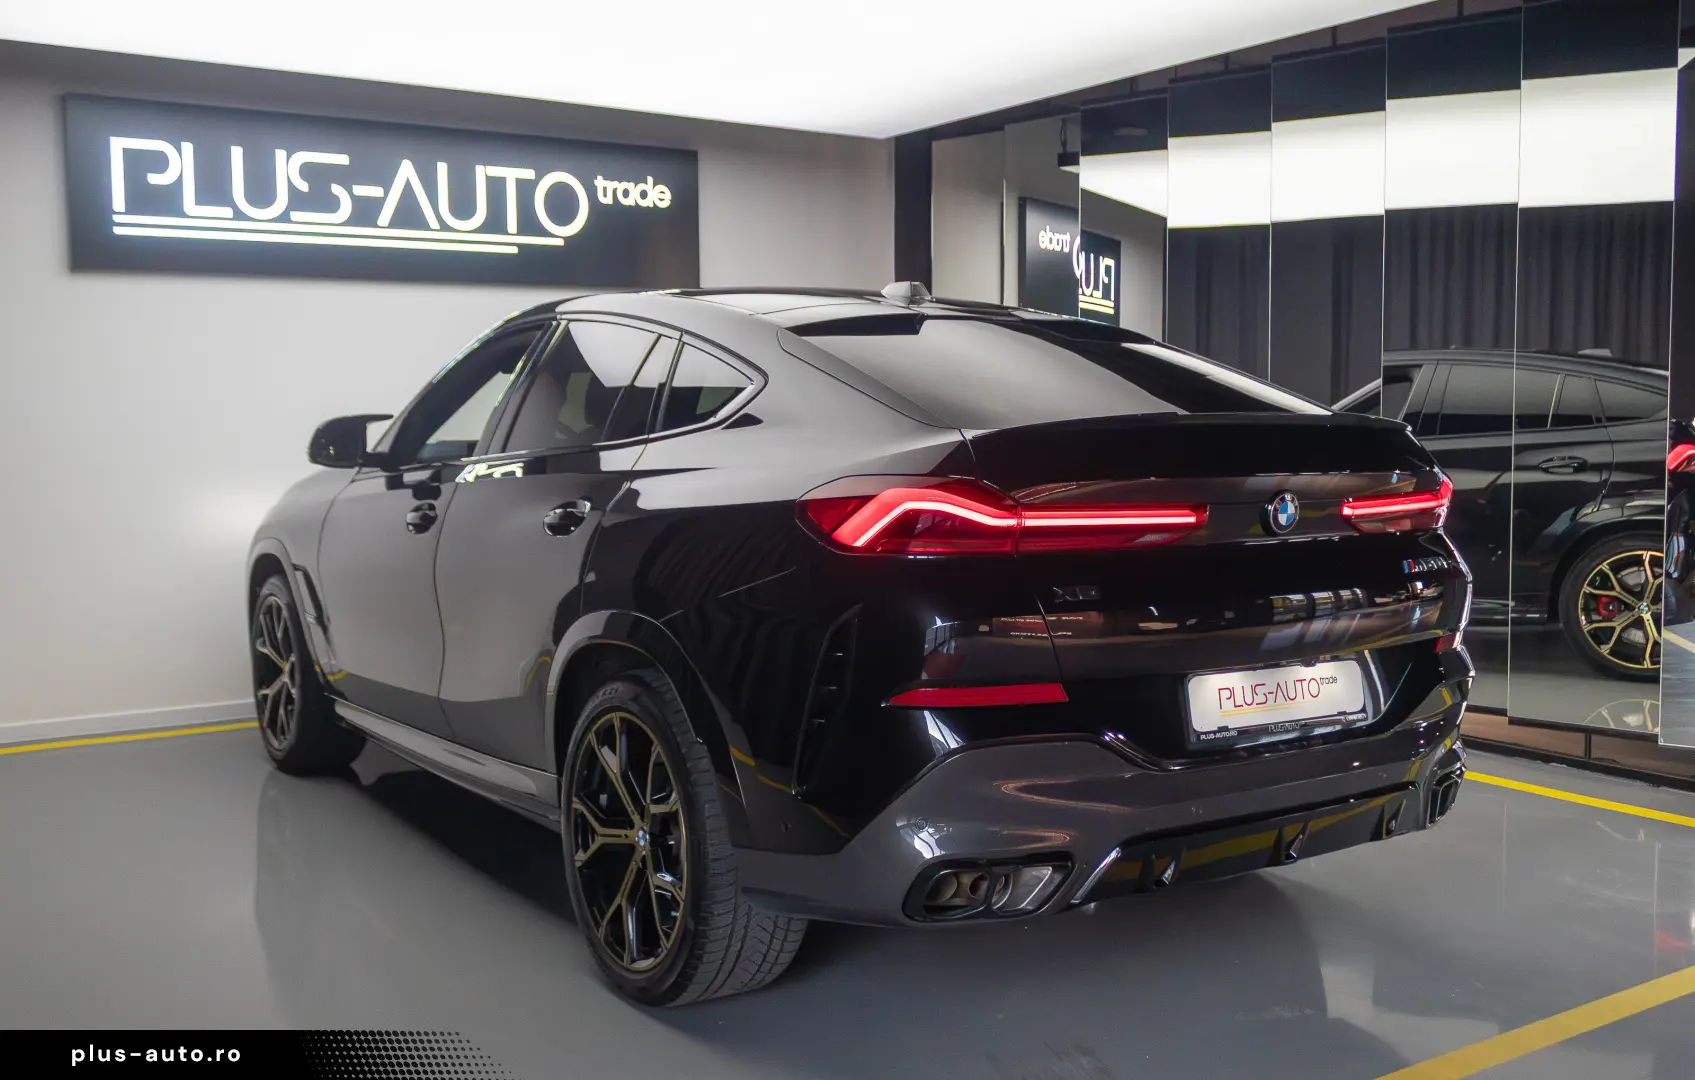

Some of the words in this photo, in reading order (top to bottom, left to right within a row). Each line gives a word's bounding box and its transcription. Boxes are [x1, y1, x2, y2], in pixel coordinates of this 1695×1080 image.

[109, 135, 589, 237] PLUS-AUTO
[594, 175, 673, 209] trade
[1217, 677, 1321, 710] PLUS-AUTO
[1319, 675, 1338, 686] trade
